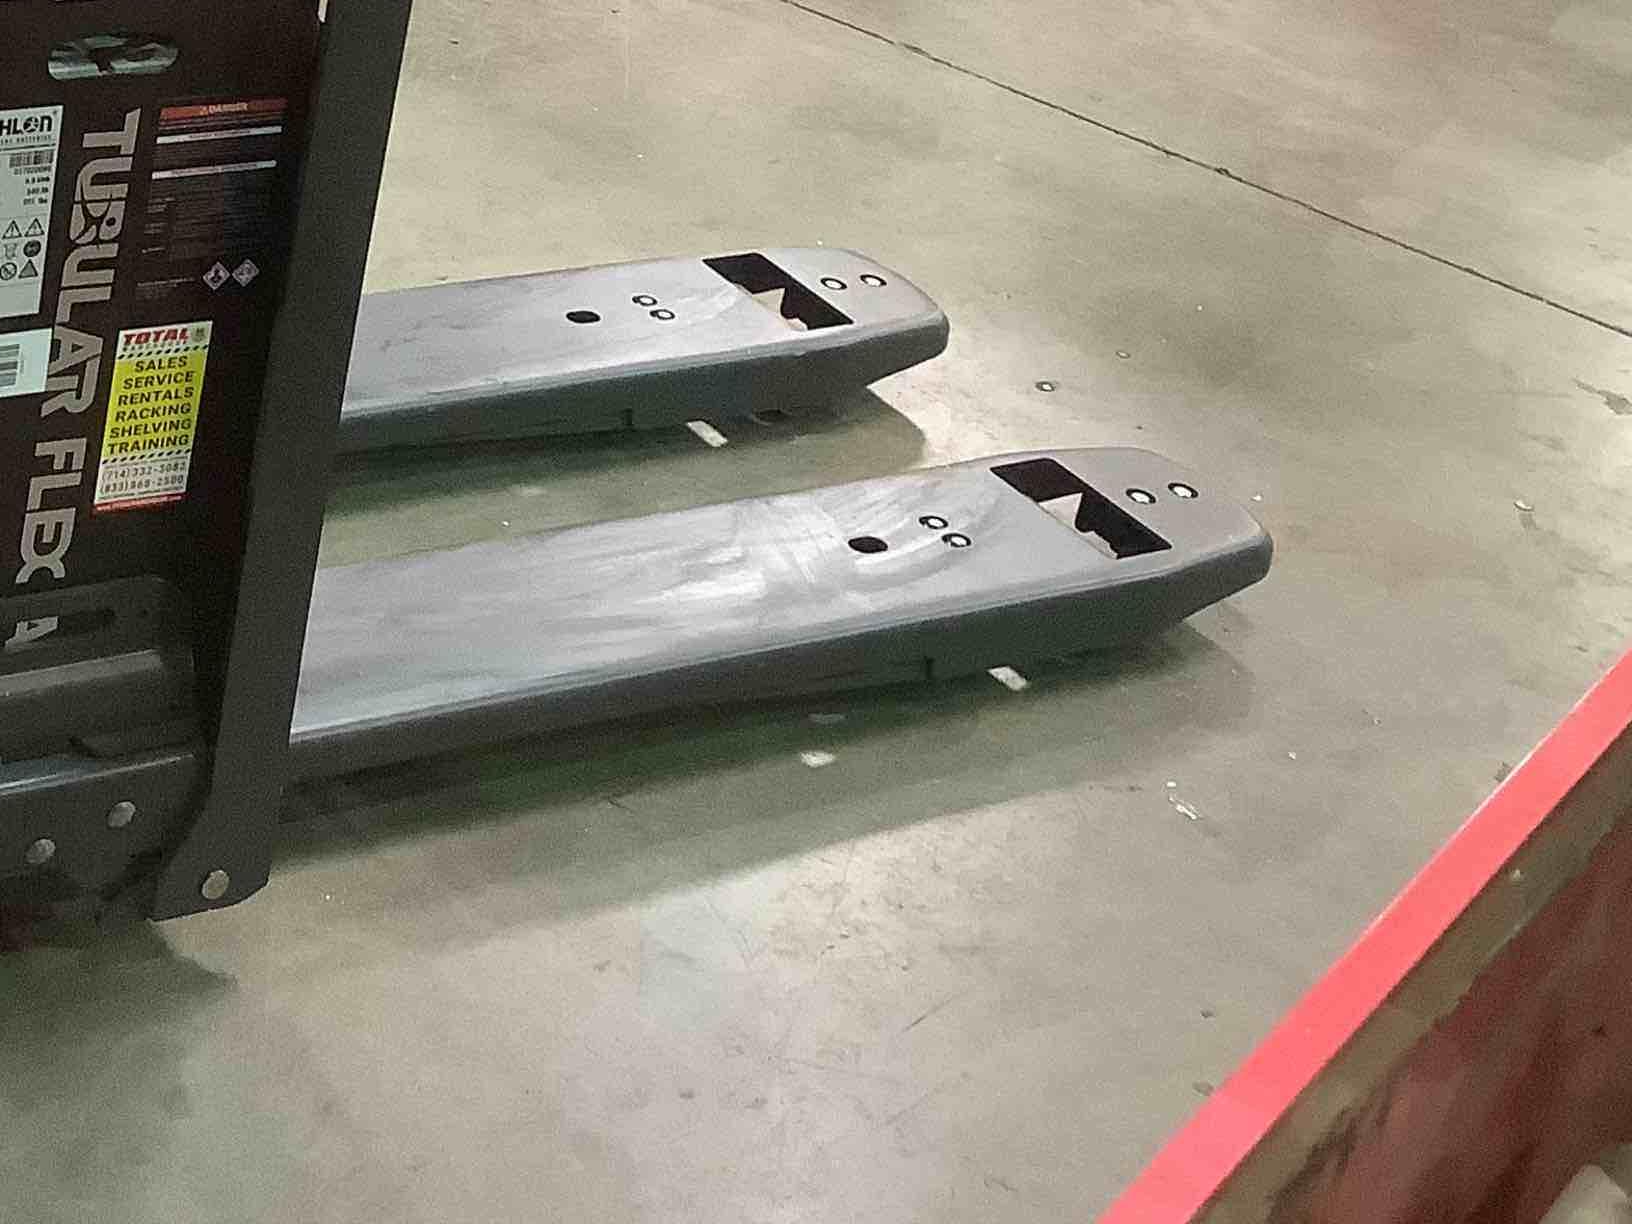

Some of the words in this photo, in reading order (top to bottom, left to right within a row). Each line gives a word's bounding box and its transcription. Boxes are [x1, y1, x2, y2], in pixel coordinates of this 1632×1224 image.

[41, 108, 142, 417] TUBULAR
[124, 327, 190, 345] TOTAL
[135, 356, 188, 372] SALES
[123, 371, 195, 389] SERVICE
[118, 387, 194, 406] RENTALS
[115, 403, 192, 423] RACKING
[109, 419, 192, 438] SHELVING
[108, 435, 189, 454] TRAINING
[16, 438, 88, 584] FLEX
